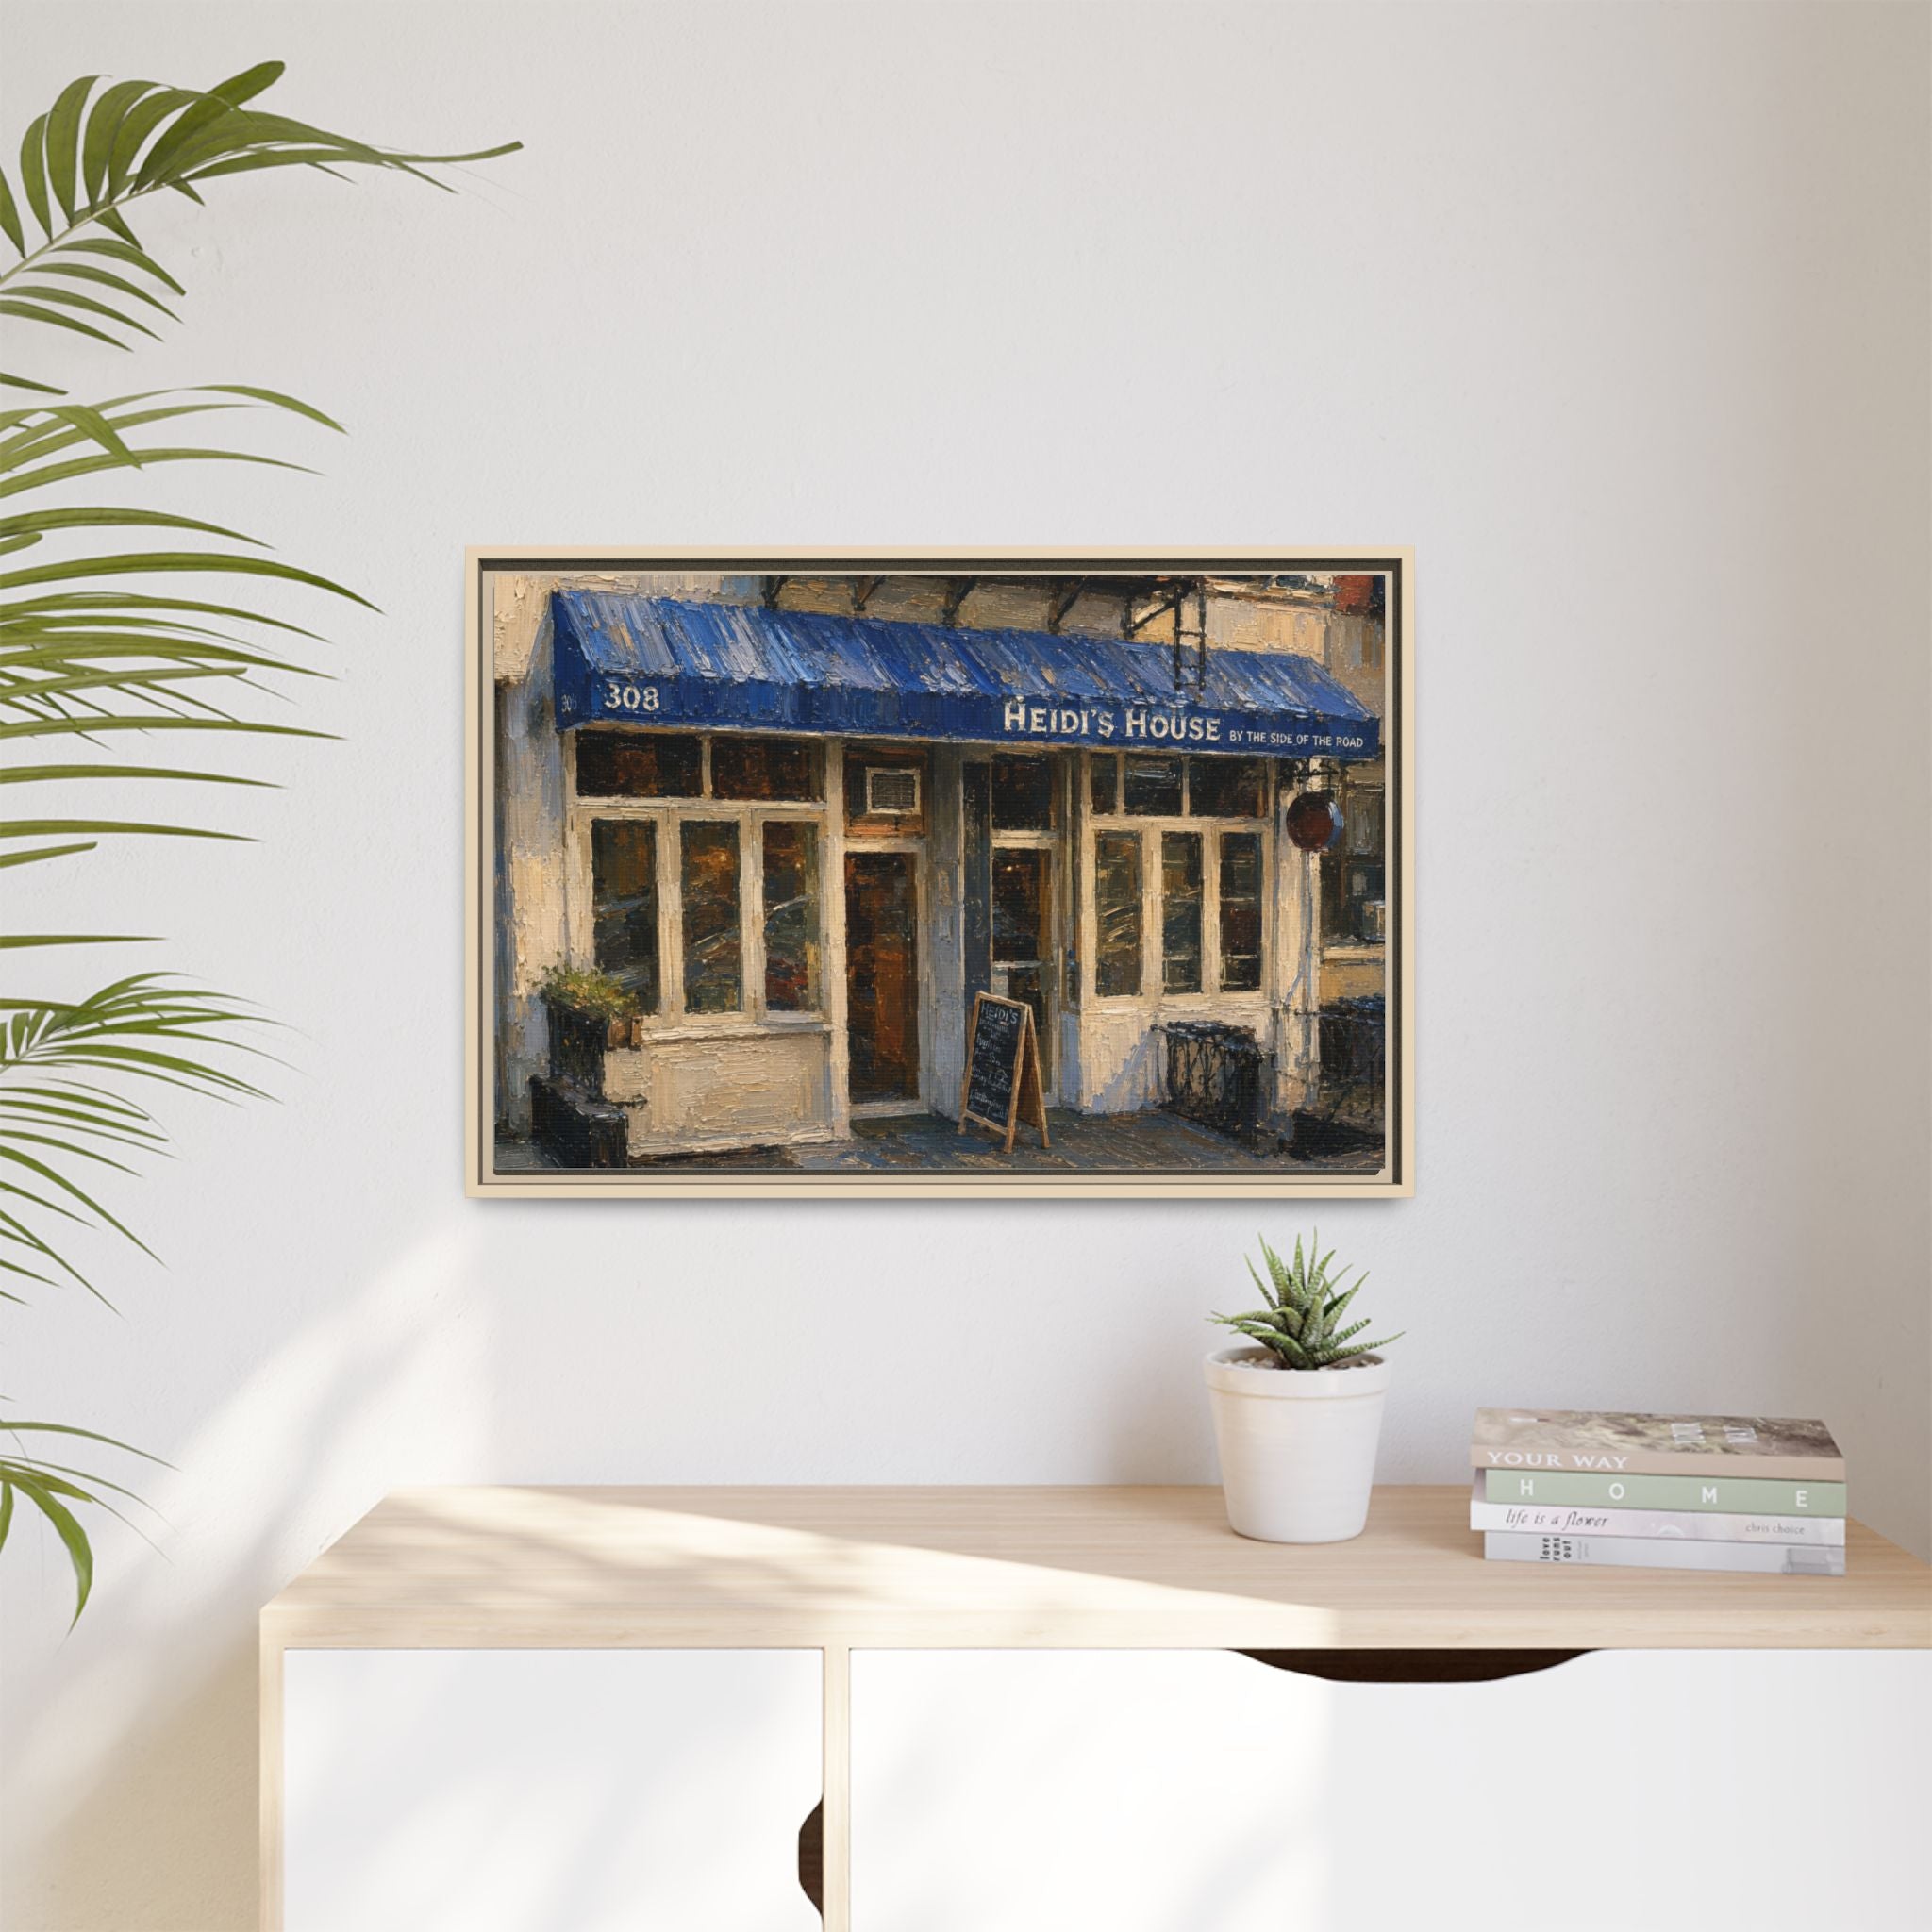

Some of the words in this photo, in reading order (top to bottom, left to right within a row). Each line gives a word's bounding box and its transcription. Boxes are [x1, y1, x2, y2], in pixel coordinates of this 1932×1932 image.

[604, 683, 659, 711] 308
[1125, 708, 1221, 741] HOUSE
[1229, 730, 1243, 741] BY
[1246, 731, 1267, 742] THE
[1270, 732, 1293, 744] SIDE
[1296, 734, 1309, 745] OF
[1312, 735, 1332, 746] THE
[1335, 736, 1364, 748] ROAD
[1487, 1451, 1563, 1467] YOUR
[1572, 1454, 1628, 1469] WAY
[1506, 1508, 1529, 1529] life
[1534, 1511, 1546, 1525] is
[1550, 1515, 1560, 1525] a
[1561, 1510, 1609, 1531] flower
[1745, 1520, 1770, 1533] chris
[1539, 1537, 1550, 1560] love
[1553, 1537, 1561, 1561] runs
[1562, 1540, 1572, 1559] out
